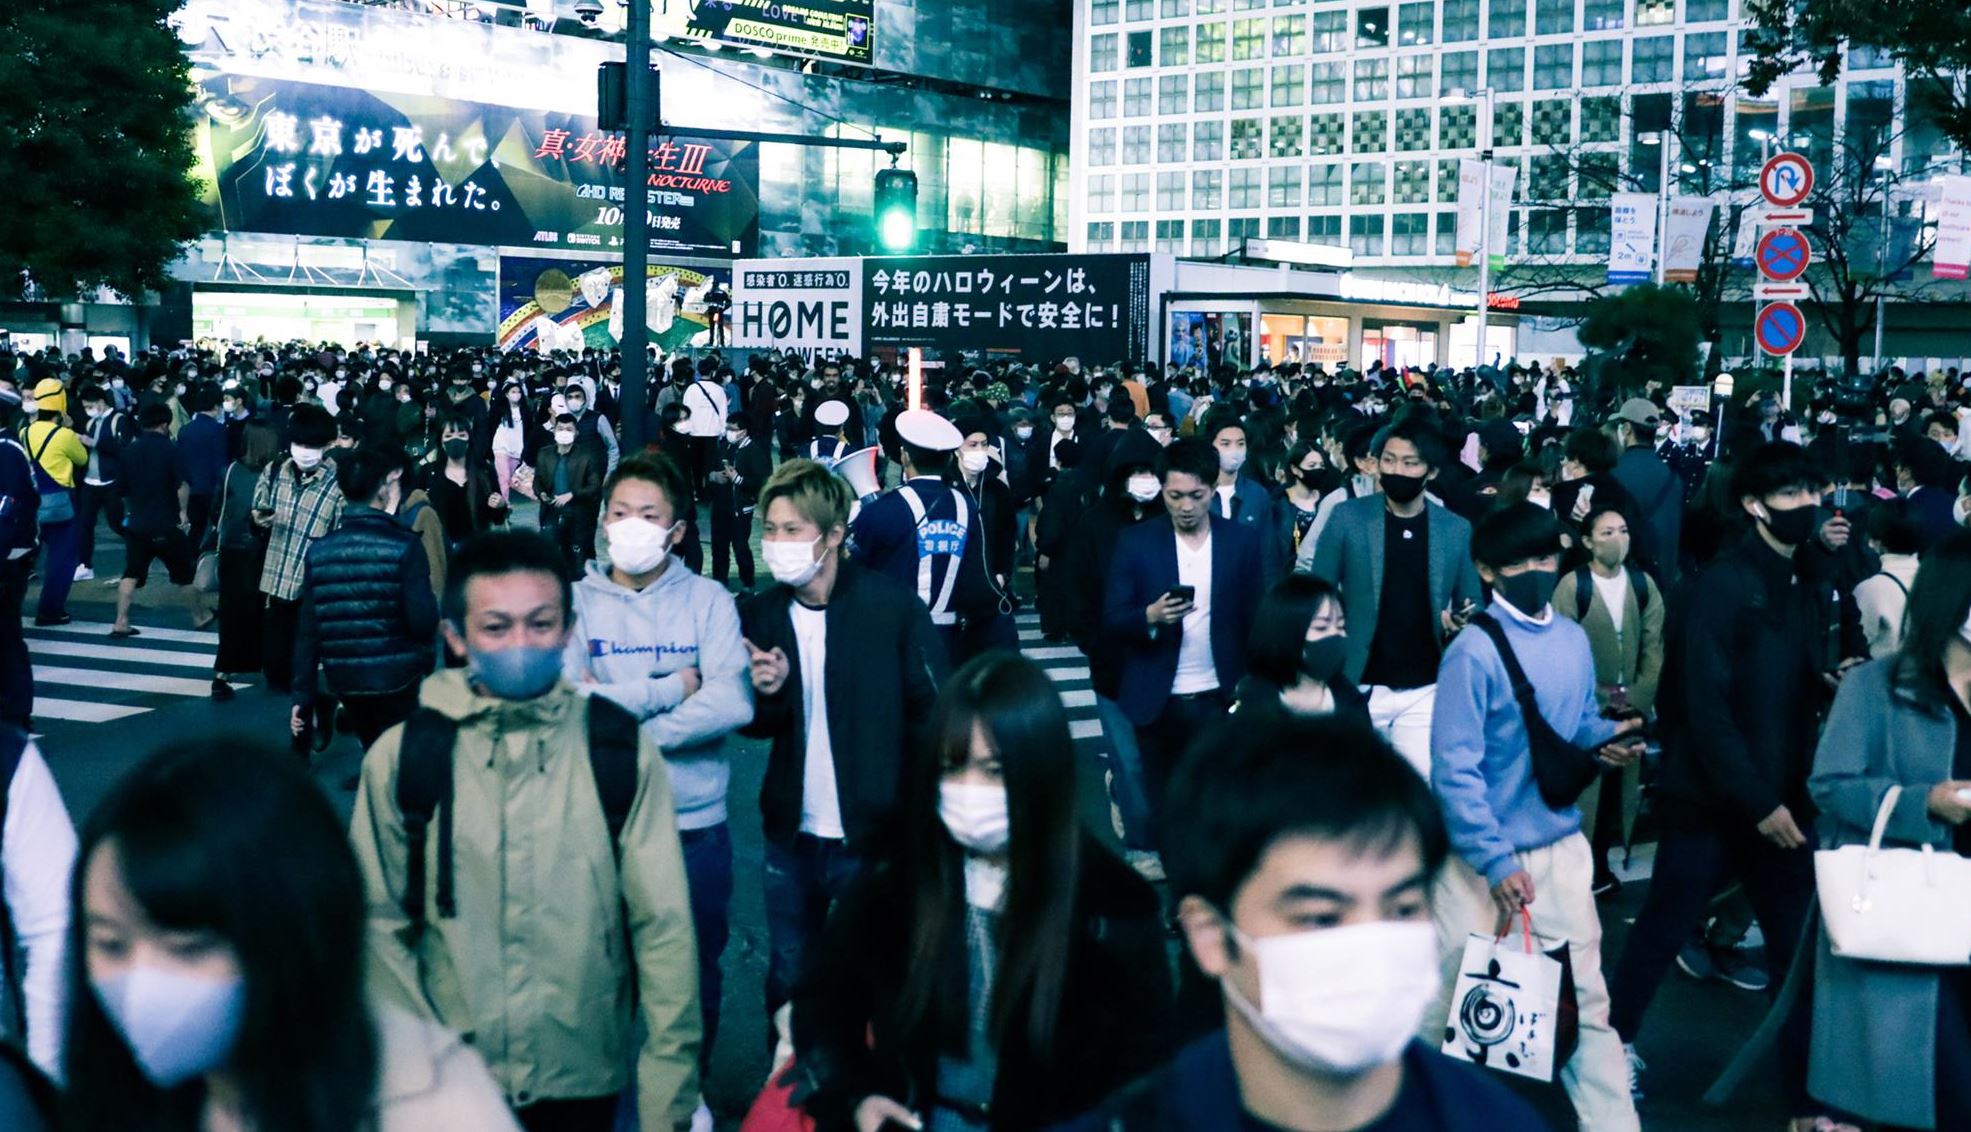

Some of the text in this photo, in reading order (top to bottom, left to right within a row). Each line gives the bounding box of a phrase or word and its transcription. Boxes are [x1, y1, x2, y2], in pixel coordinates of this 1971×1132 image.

[735, 22, 774, 39] DOSCO
[776, 31, 807, 48] prime
[264, 112, 500, 168] 東京が死んで、
[265, 162, 500, 210] ぼくが生まれた。
[647, 173, 732, 195] NOCTURNE
[871, 268, 1096, 295] 今年のハロウィーンは、
[871, 301, 1118, 329] 外出自粛モードで安全に!
[919, 520, 967, 539] POLICE
[587, 638, 699, 662] Champion
